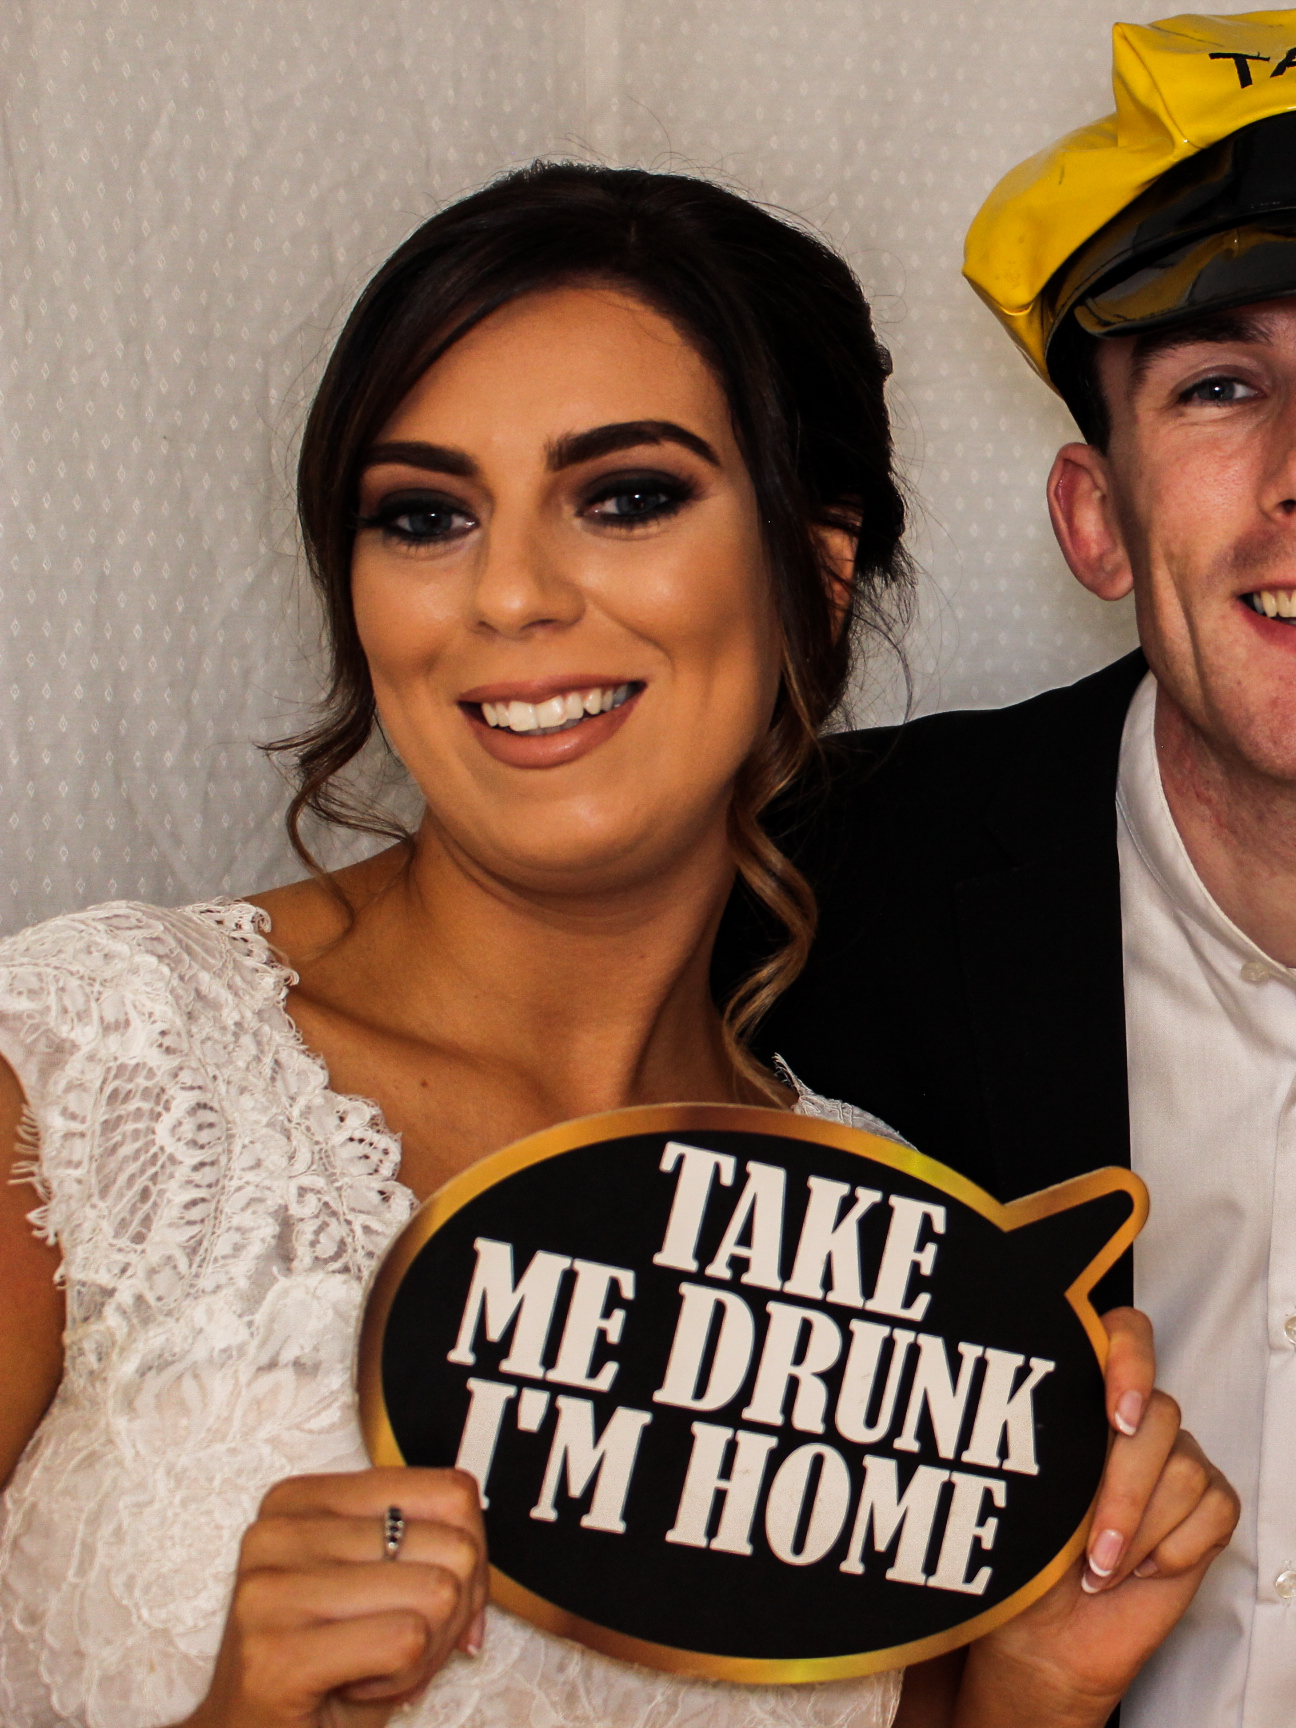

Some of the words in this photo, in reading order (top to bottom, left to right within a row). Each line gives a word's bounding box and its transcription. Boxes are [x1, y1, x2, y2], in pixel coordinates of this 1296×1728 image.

[652, 1140, 947, 1323] TAKE
[446, 1237, 636, 1393] ME
[652, 1281, 1056, 1477] DRUNK
[454, 1377, 653, 1535] I'M
[665, 1421, 1008, 1597] HOME
